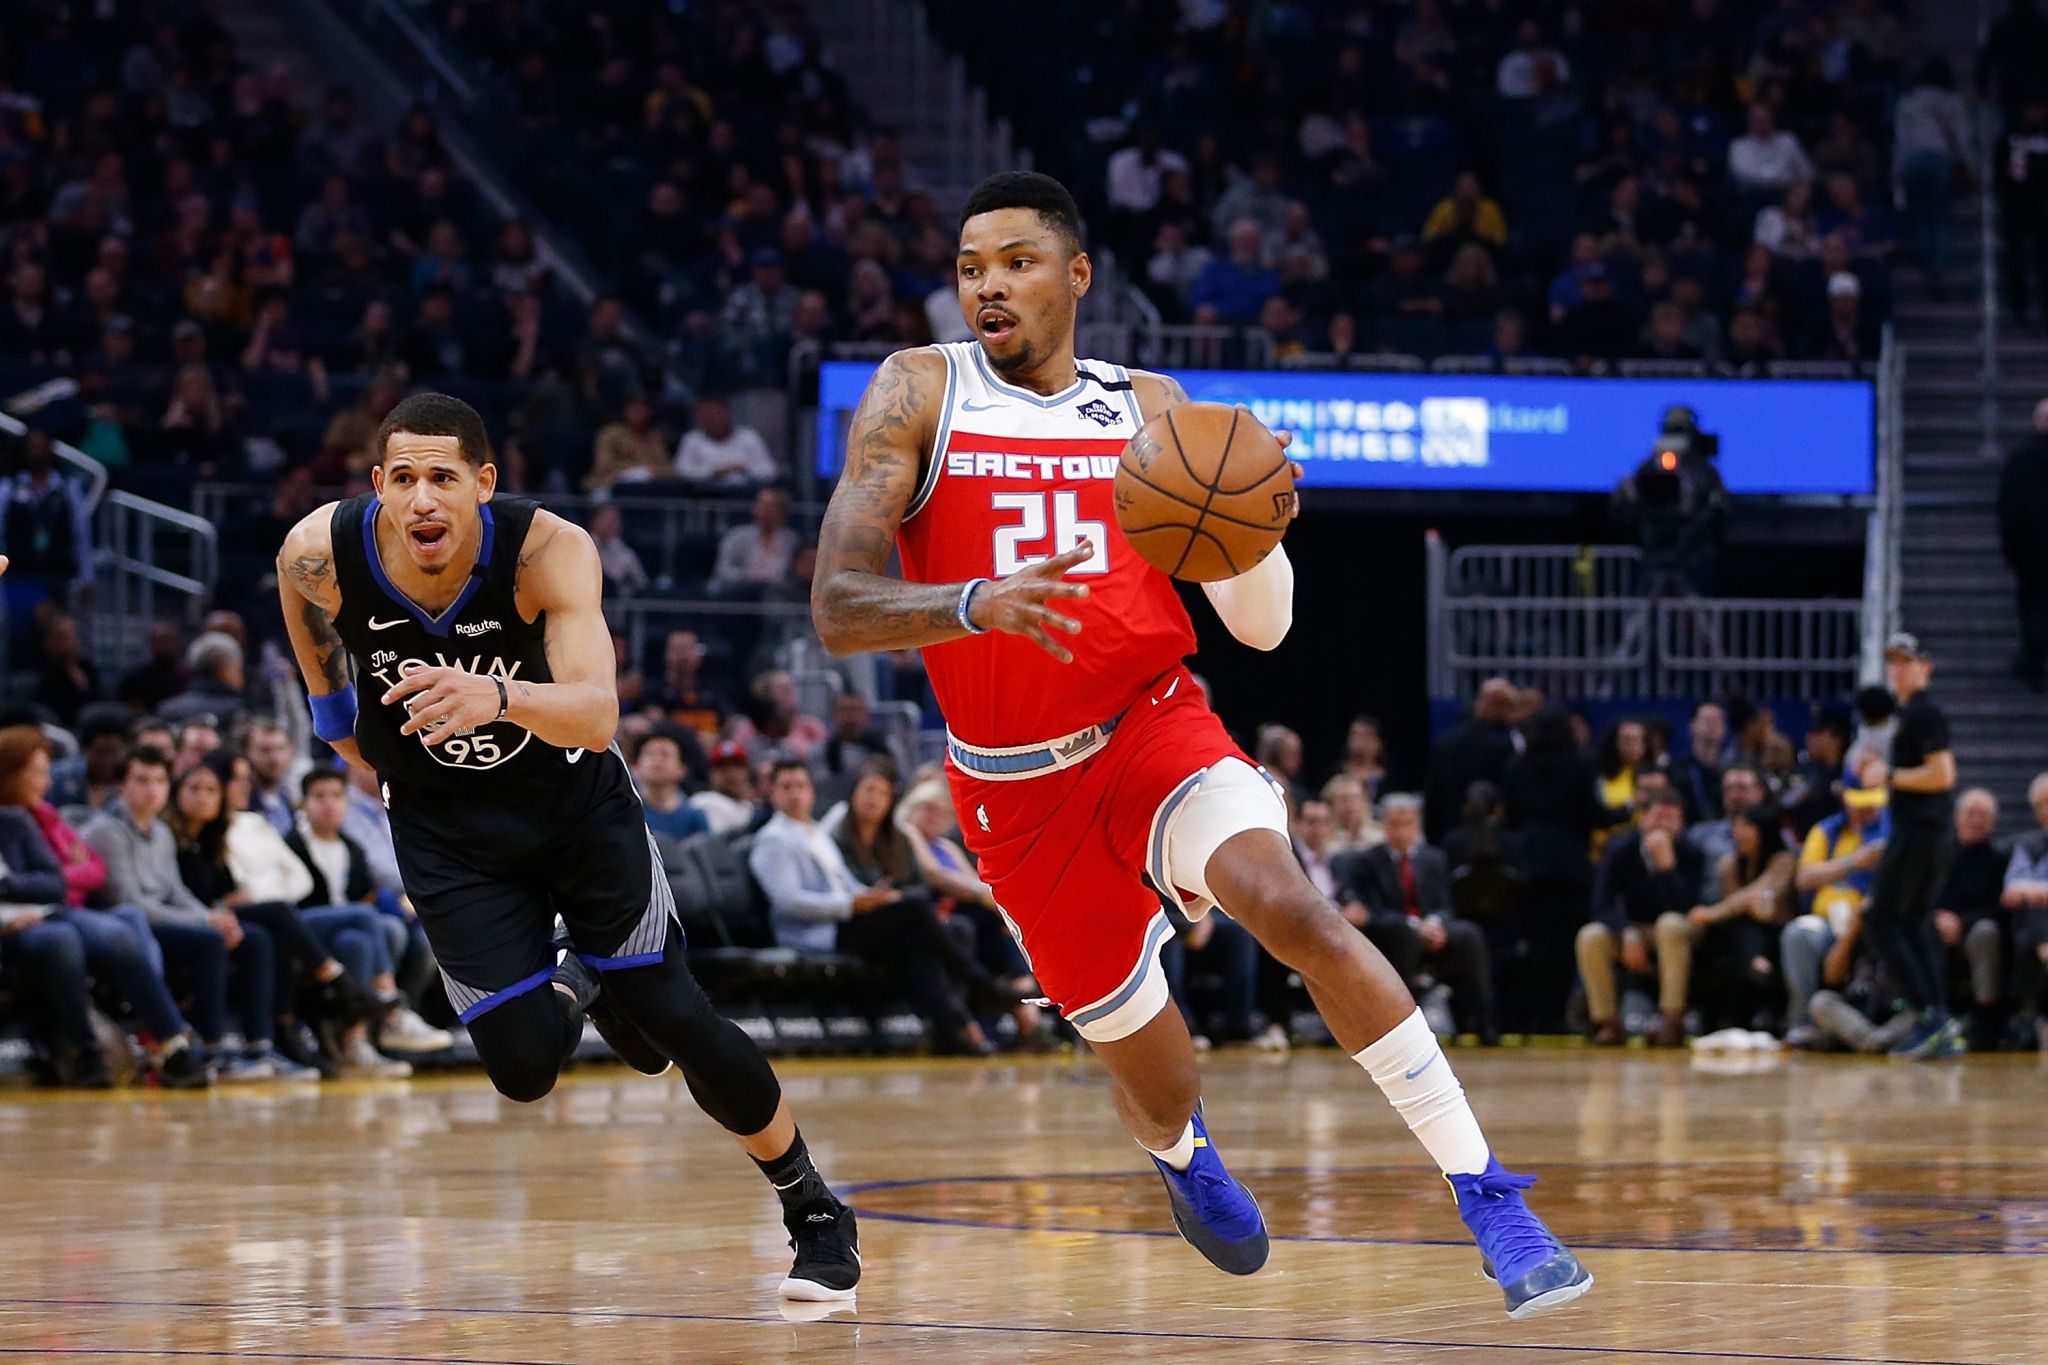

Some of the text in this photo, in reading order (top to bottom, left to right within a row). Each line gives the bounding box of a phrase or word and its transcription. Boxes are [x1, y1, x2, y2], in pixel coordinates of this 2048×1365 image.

[1287, 430, 1414, 461] LINES
[947, 451, 1121, 480] SACTOW
[991, 490, 1109, 577] 26
[455, 620, 502, 635] Rakuten
[371, 650, 398, 668] The
[444, 734, 501, 764] 95
